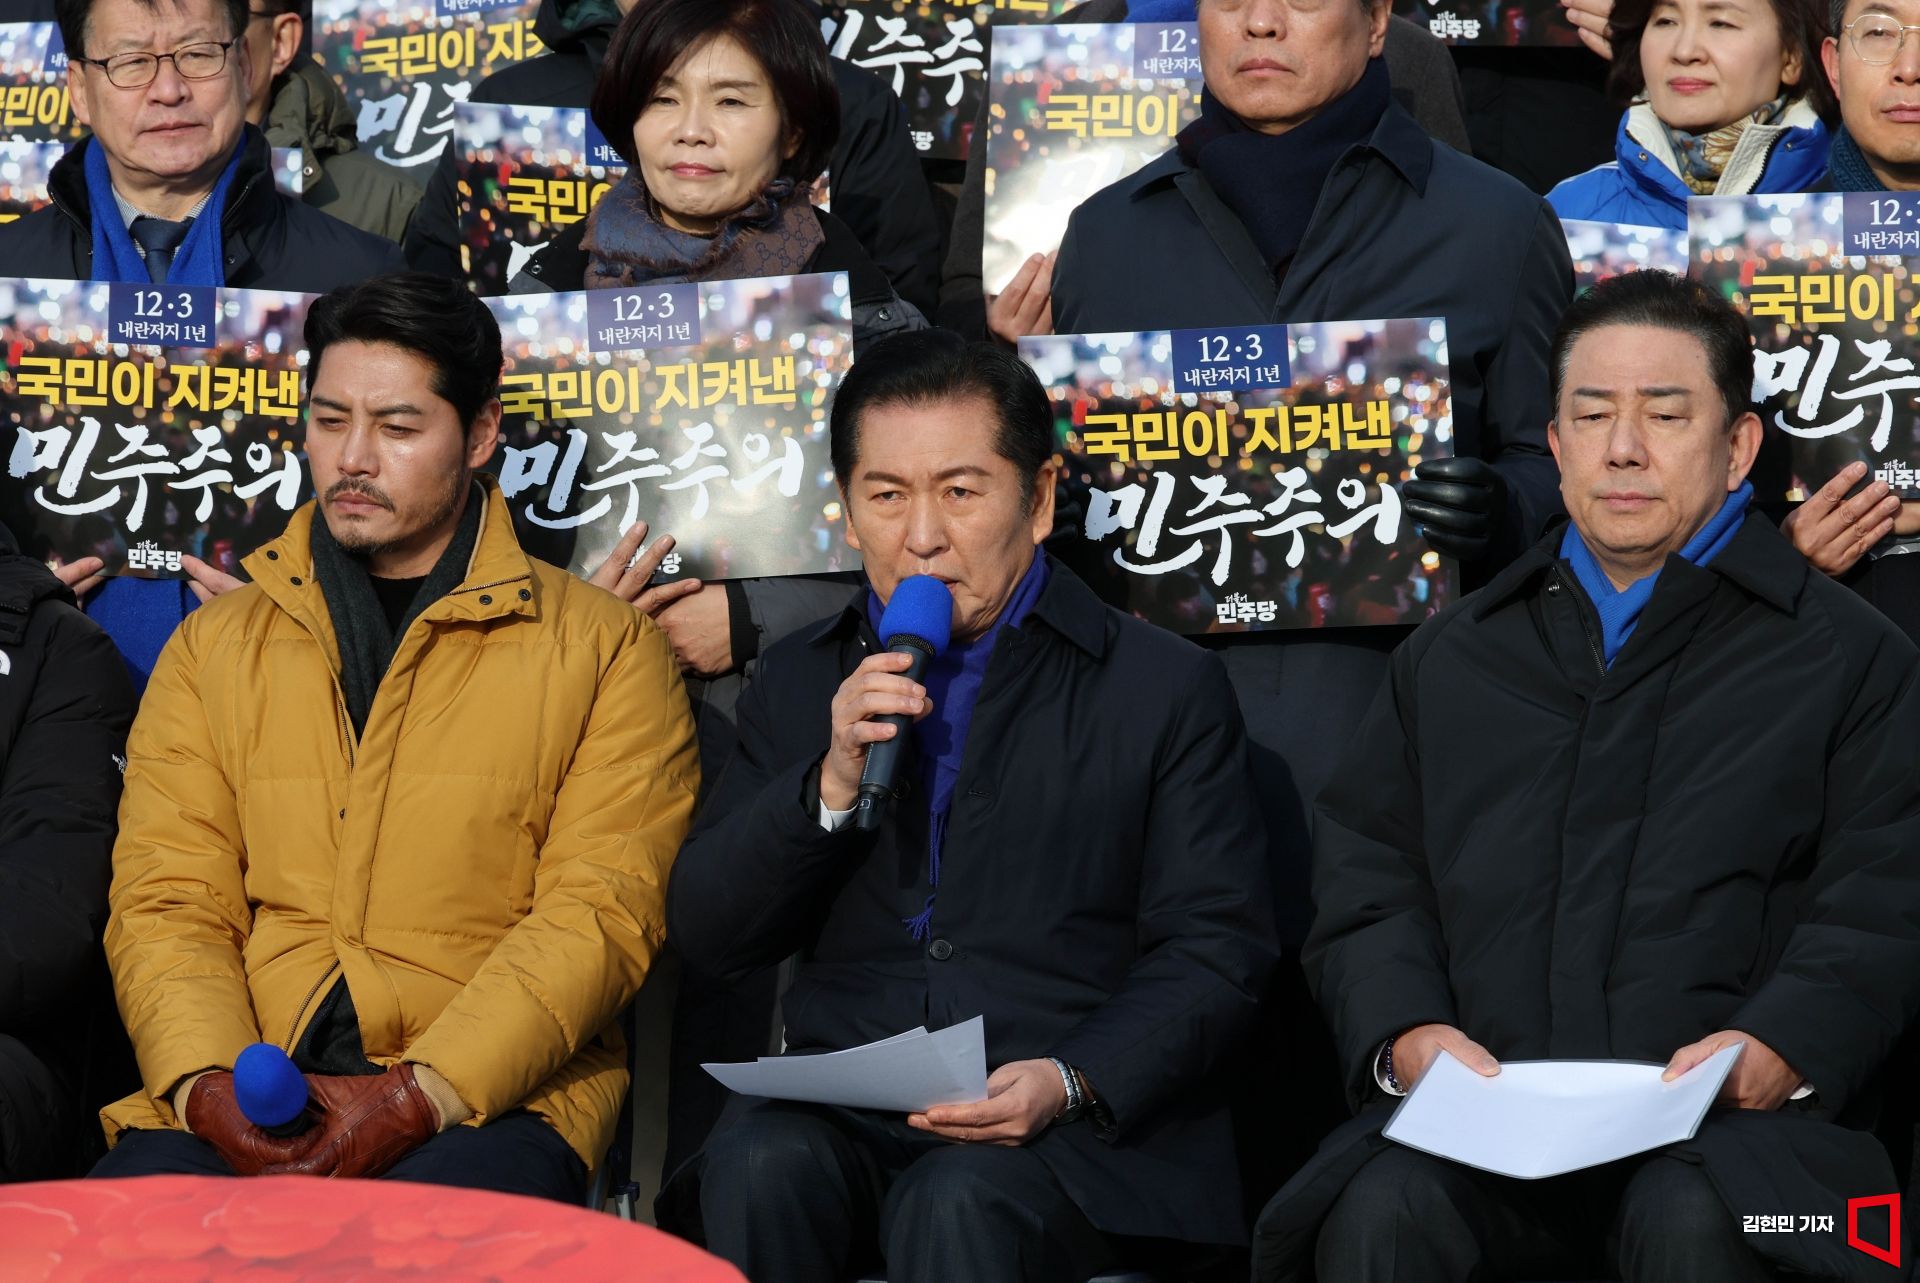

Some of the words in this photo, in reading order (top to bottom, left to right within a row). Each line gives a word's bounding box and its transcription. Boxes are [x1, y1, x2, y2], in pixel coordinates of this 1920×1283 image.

[1159, 29, 1198, 52] 12·
[1430, 19, 1481, 38] 민주당
[361, 27, 475, 77] 국민이
[820, 9, 985, 106] 주주
[0, 86, 70, 126] 민이
[1046, 95, 1179, 137] 국민이
[1869, 199, 1920, 225] 12·
[1854, 231, 1920, 250] 내란저지
[134, 291, 193, 318] 12·3
[612, 293, 675, 322] 12·3
[1751, 273, 1895, 323] 국민이
[118, 321, 179, 341] 내란저지
[184, 325, 206, 343] 1년
[598, 325, 662, 346] 내란저지
[667, 321, 691, 341] 1년
[1198, 333, 1263, 363] 12·3
[16, 356, 154, 409] 국민이
[168, 364, 299, 418] 지켜낸
[500, 366, 640, 421] 국민이
[655, 355, 796, 410] 지켜낸
[1184, 367, 1250, 387] 내란저지
[1256, 364, 1281, 384] 1년
[1751, 334, 1920, 452] 민주
[1083, 408, 1228, 462] 국민이
[1244, 400, 1392, 453] 지켜낸
[8, 416, 302, 533] 민주주의
[499, 422, 804, 538] 민주주의
[1084, 466, 1402, 587] 민주주의
[128, 548, 182, 572] 민주당
[1216, 600, 1278, 624] 민주당
